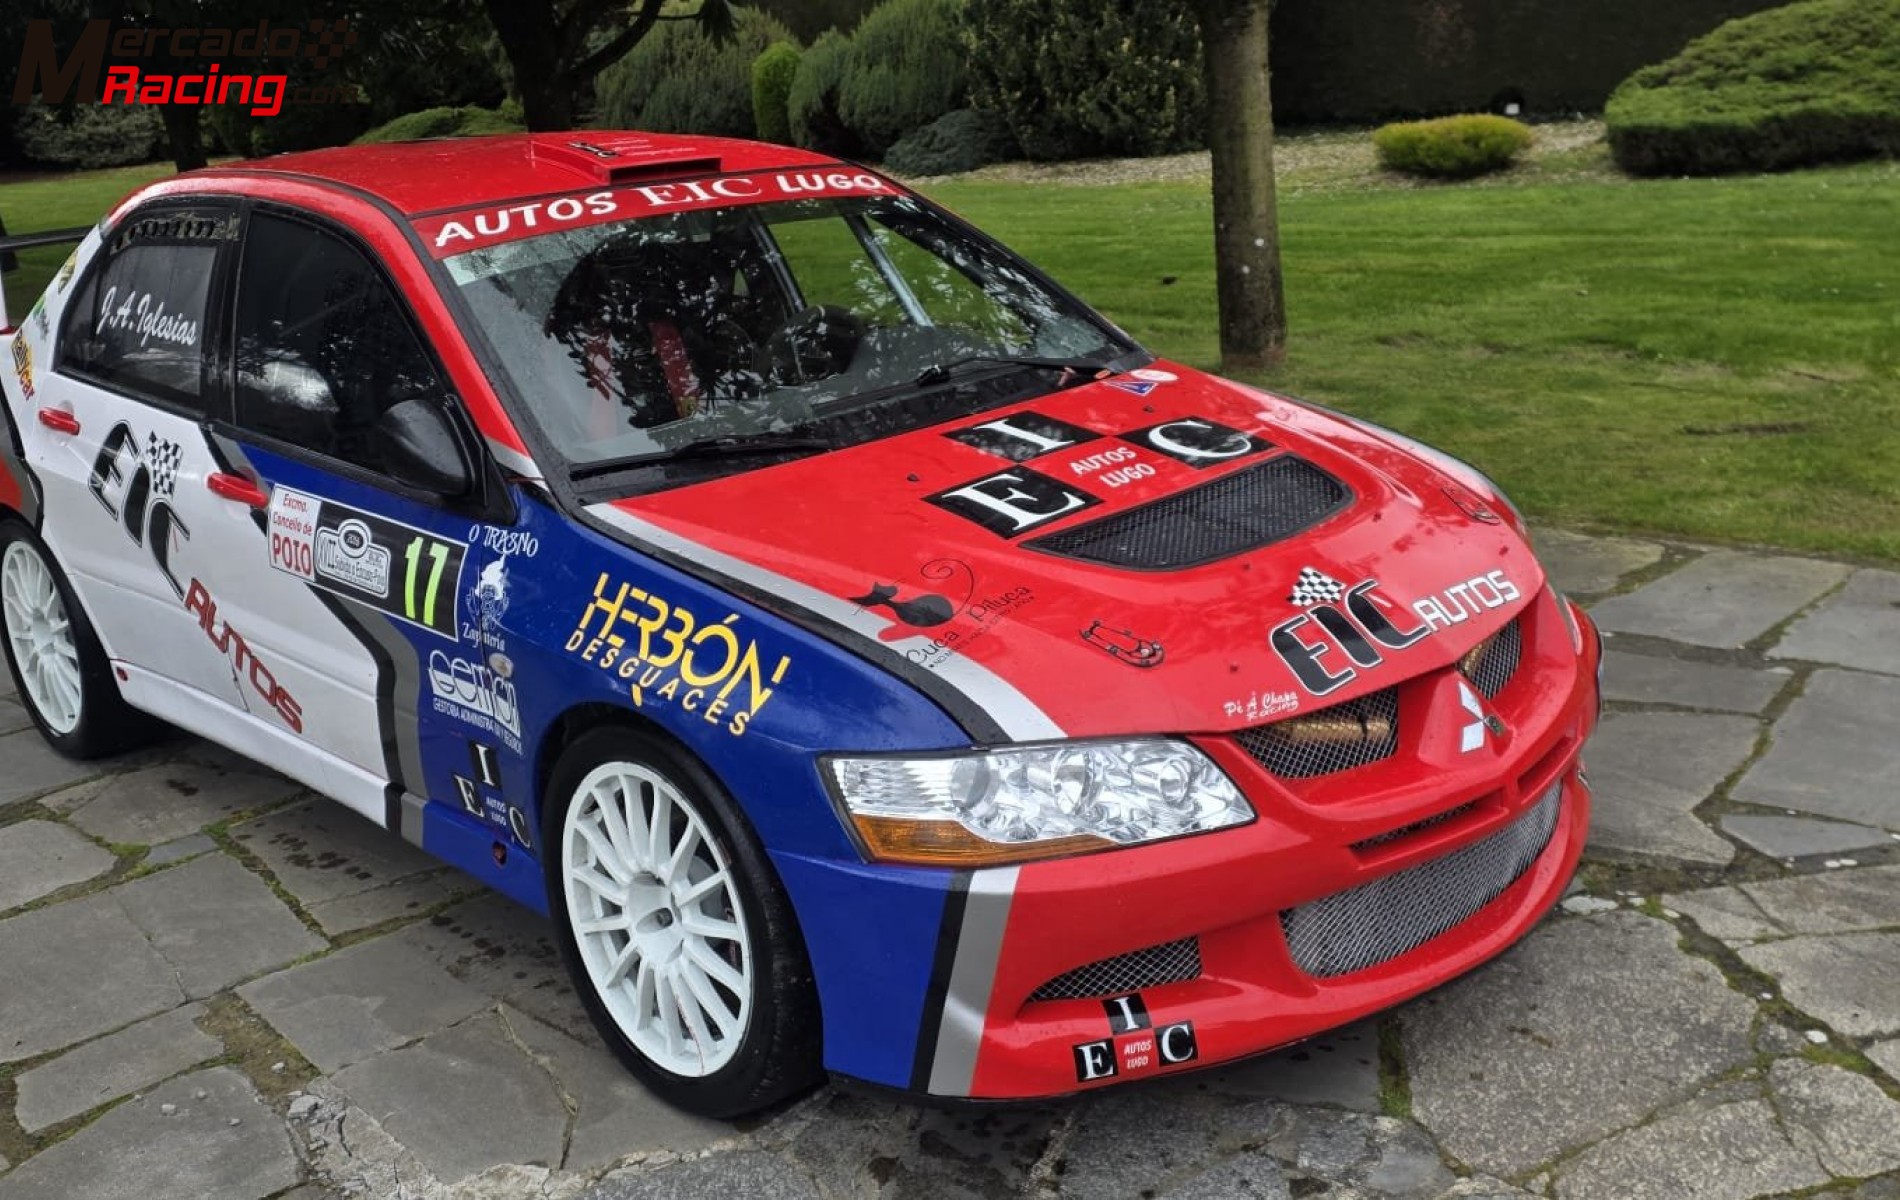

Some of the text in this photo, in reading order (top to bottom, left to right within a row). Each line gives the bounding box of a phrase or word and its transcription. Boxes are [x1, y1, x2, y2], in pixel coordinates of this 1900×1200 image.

[435, 173, 883, 247] AUTOS EIC LUGO
[1069, 446, 1137, 476] AUTOS
[1098, 463, 1156, 488] LUGO
[272, 532, 312, 576] POIO
[1412, 569, 1521, 632] AUTOS
[185, 576, 304, 734] AUTOS
[578, 572, 791, 716] HERBÓN
[565, 628, 750, 737] DESGUACES
[1124, 1040, 1153, 1055] AUTOS
[1126, 1056, 1149, 1070] LUGO
